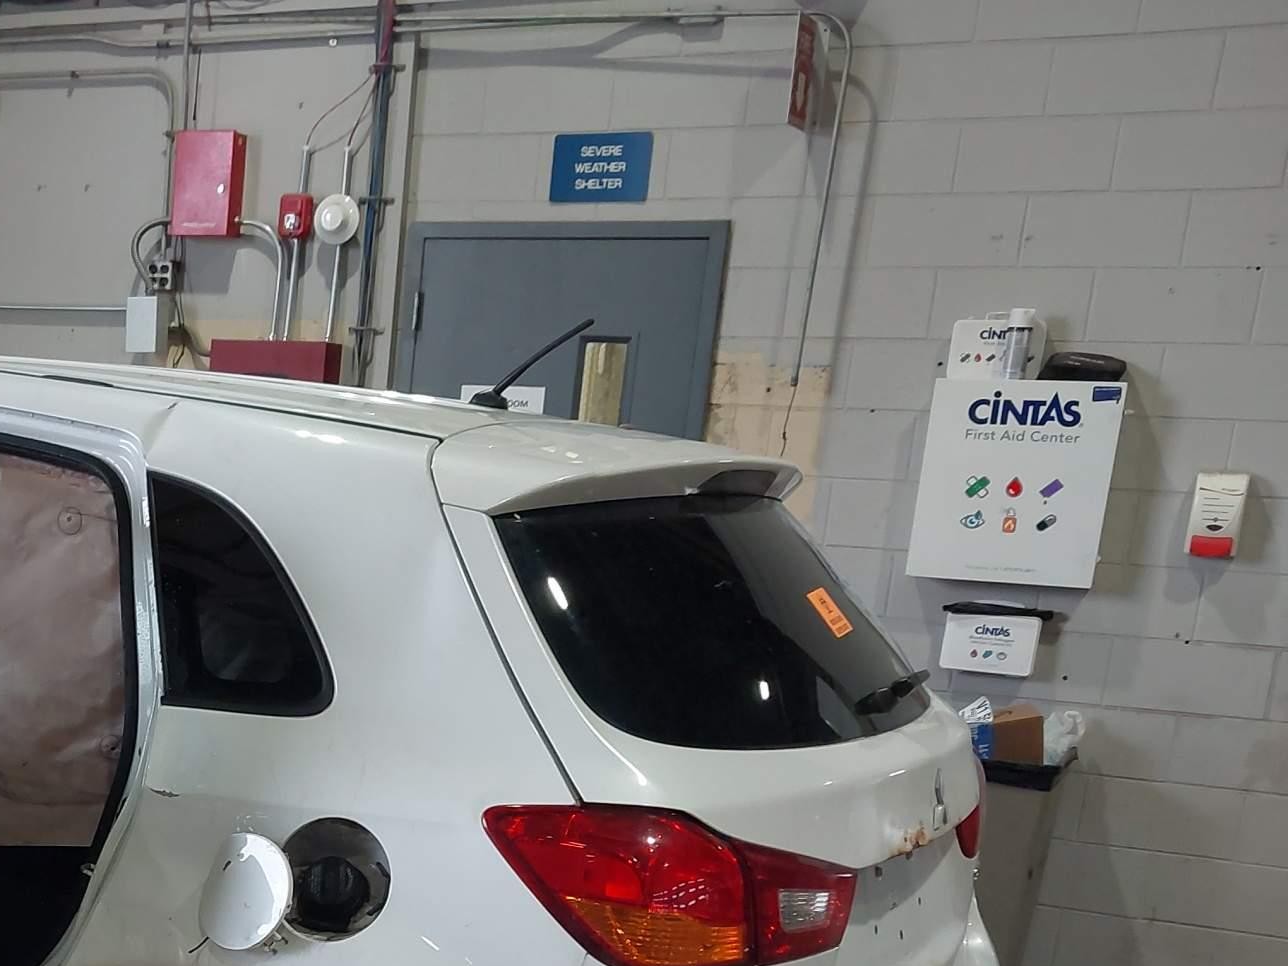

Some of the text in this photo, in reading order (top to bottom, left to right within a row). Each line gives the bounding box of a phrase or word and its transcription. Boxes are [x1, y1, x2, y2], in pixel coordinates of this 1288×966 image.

[580, 145, 623, 157] SEVERE
[574, 161, 626, 173] WEATHER
[574, 178, 623, 190] SHELTER
[965, 429, 1080, 443] First Aid Center
